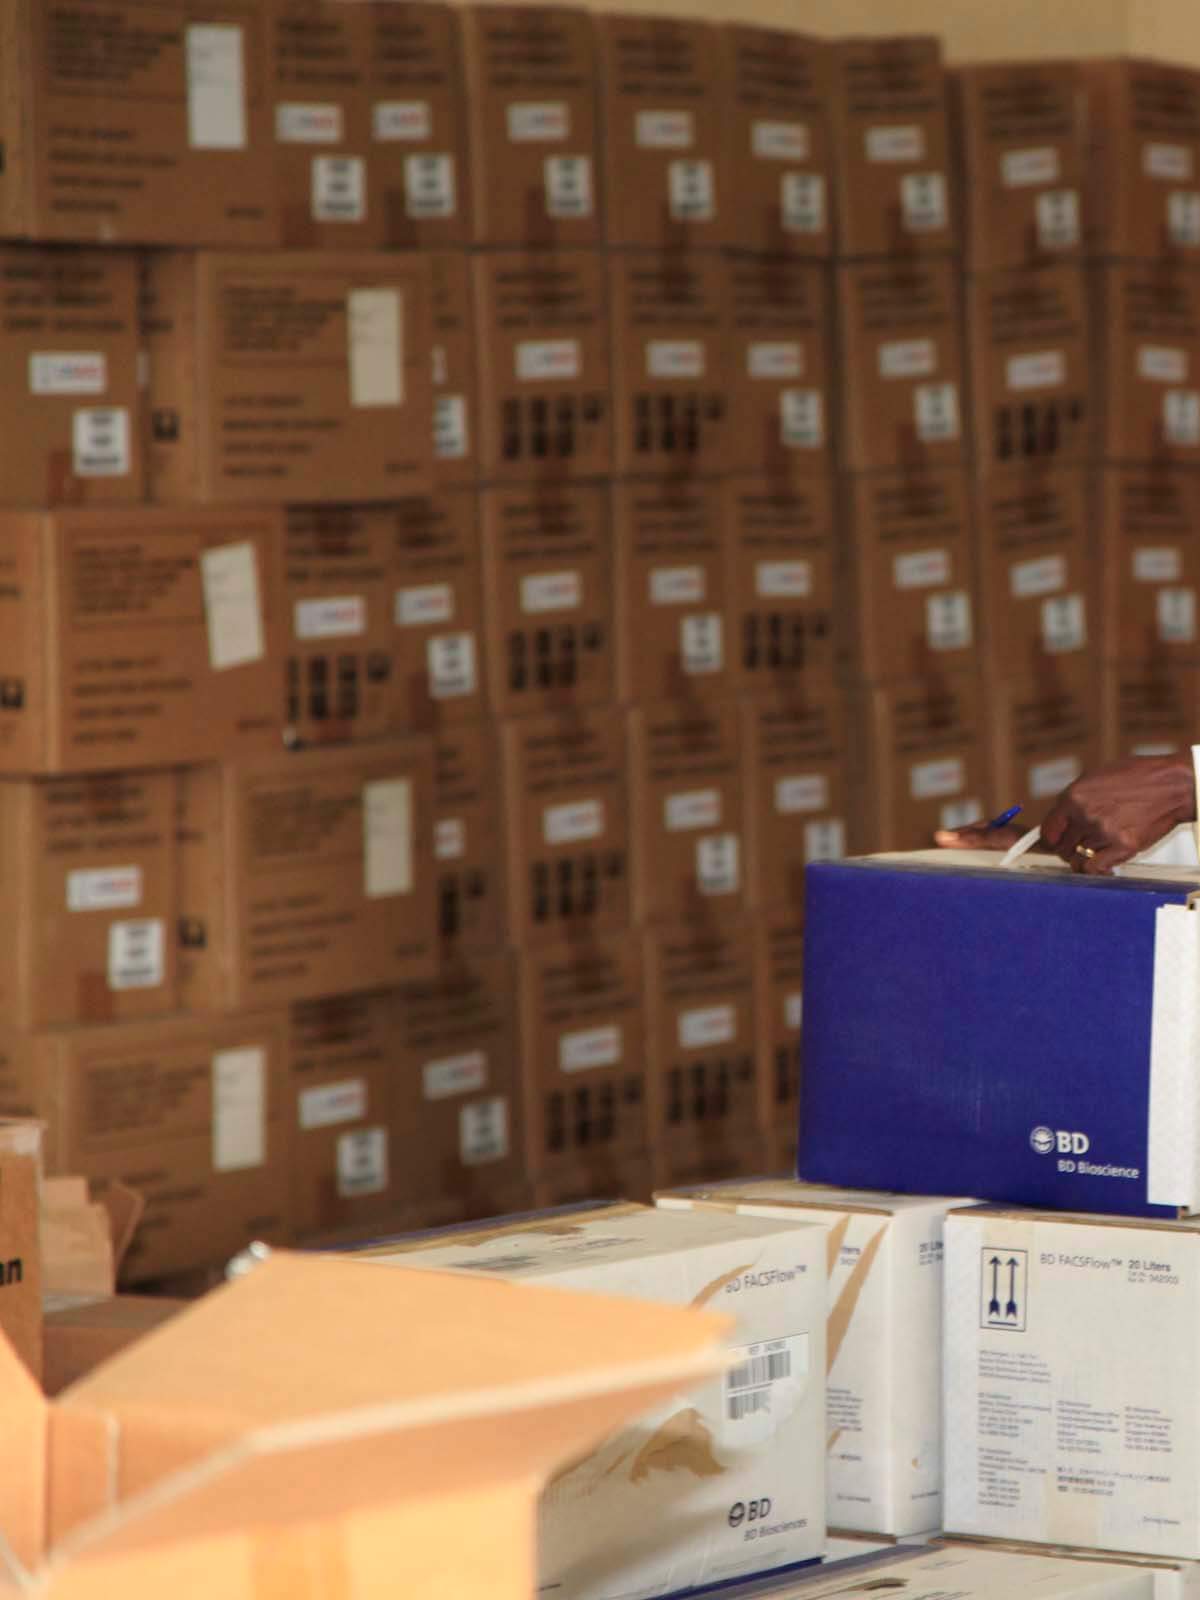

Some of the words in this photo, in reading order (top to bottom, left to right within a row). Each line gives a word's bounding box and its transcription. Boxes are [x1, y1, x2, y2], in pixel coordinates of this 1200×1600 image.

[1056, 1131, 1090, 1154] BD
[1057, 1159, 1076, 1173] BD
[1077, 1161, 1140, 1179] Bioscience
[1039, 1252, 1056, 1265] BD
[1127, 1259, 1140, 1270] 20
[1143, 1260, 1171, 1272] Liters
[748, 1498, 772, 1521] BD
[743, 1528, 758, 1542] BD
